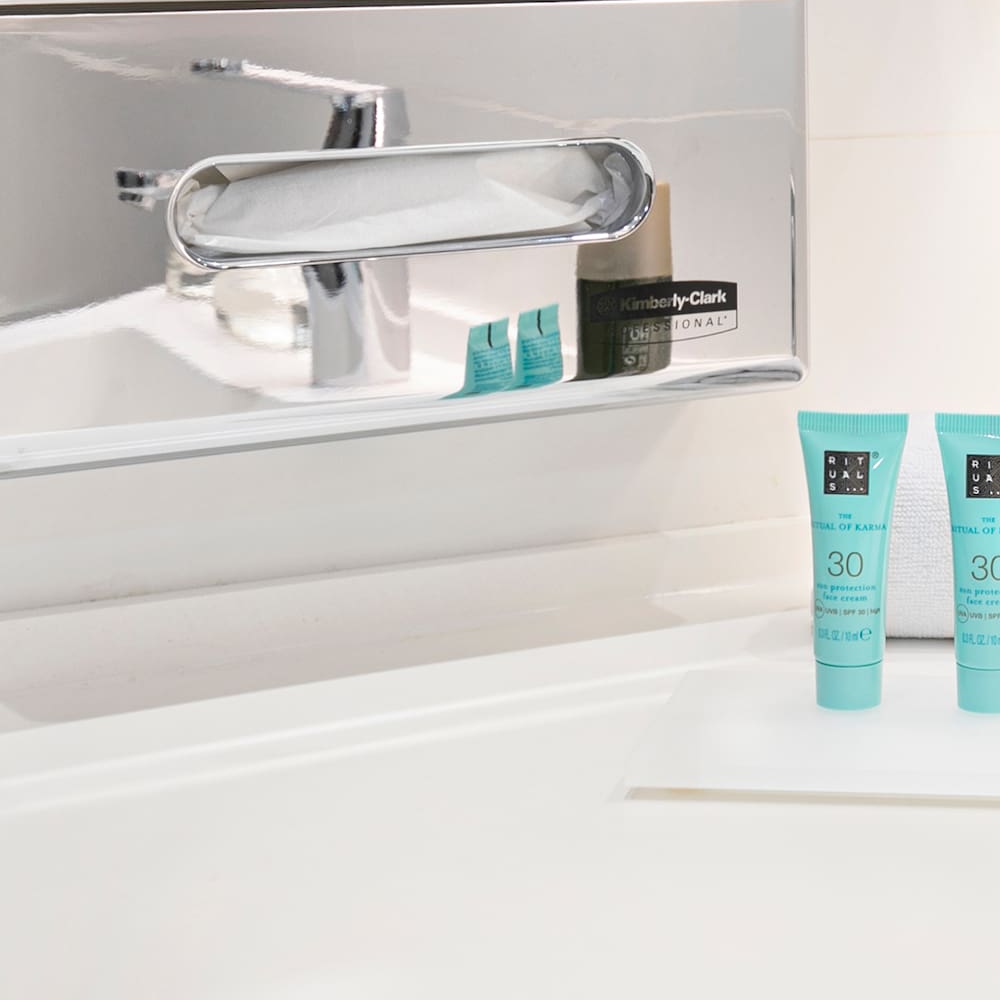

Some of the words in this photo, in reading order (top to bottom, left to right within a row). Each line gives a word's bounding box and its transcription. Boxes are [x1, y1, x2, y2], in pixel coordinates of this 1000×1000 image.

[839, 522, 852, 530] OF
[855, 523, 887, 531] KARMA
[982, 527, 996, 535] OF
[827, 551, 863, 577] 30
[830, 585, 876, 593] protection
[823, 591, 839, 601] face
[966, 596, 983, 605] face
